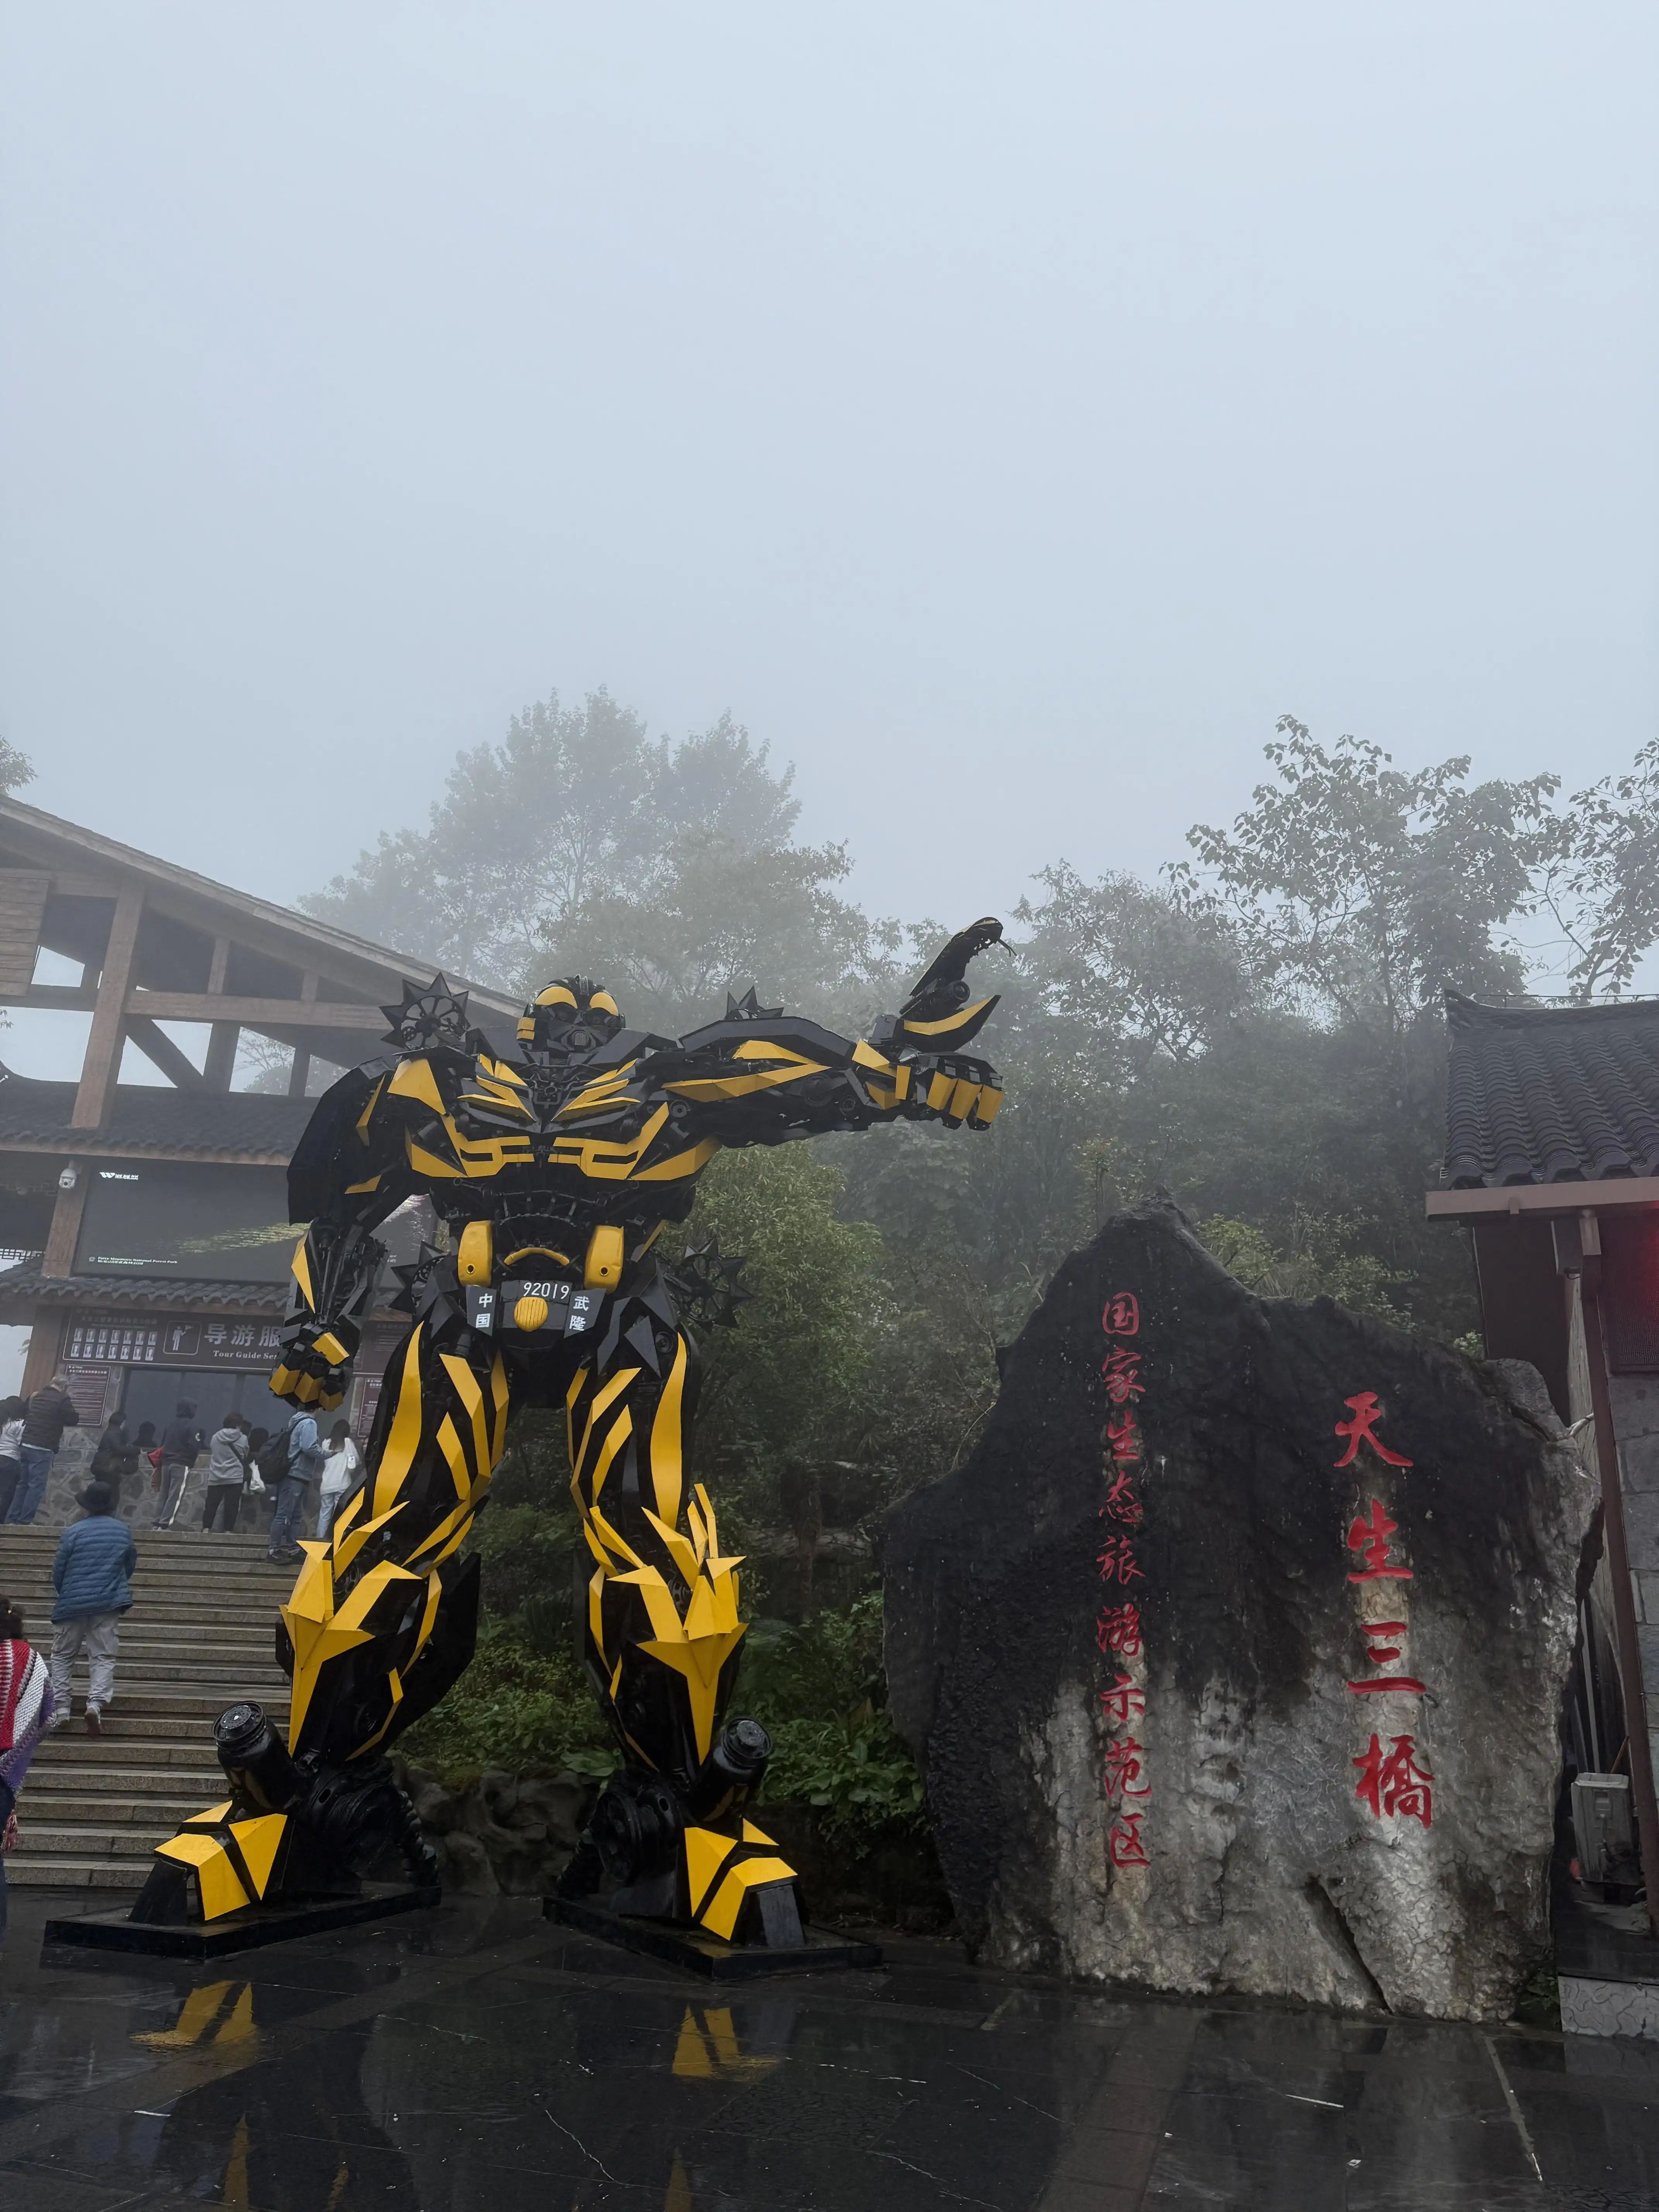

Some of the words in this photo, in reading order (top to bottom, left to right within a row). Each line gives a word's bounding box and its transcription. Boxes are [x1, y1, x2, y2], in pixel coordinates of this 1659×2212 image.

[523, 1282, 570, 1300] 92019
[475, 1293, 493, 1329] 中国
[569, 1295, 590, 1331] 武隆
[1096, 1291, 1152, 1868] 国家生态旅游示范区
